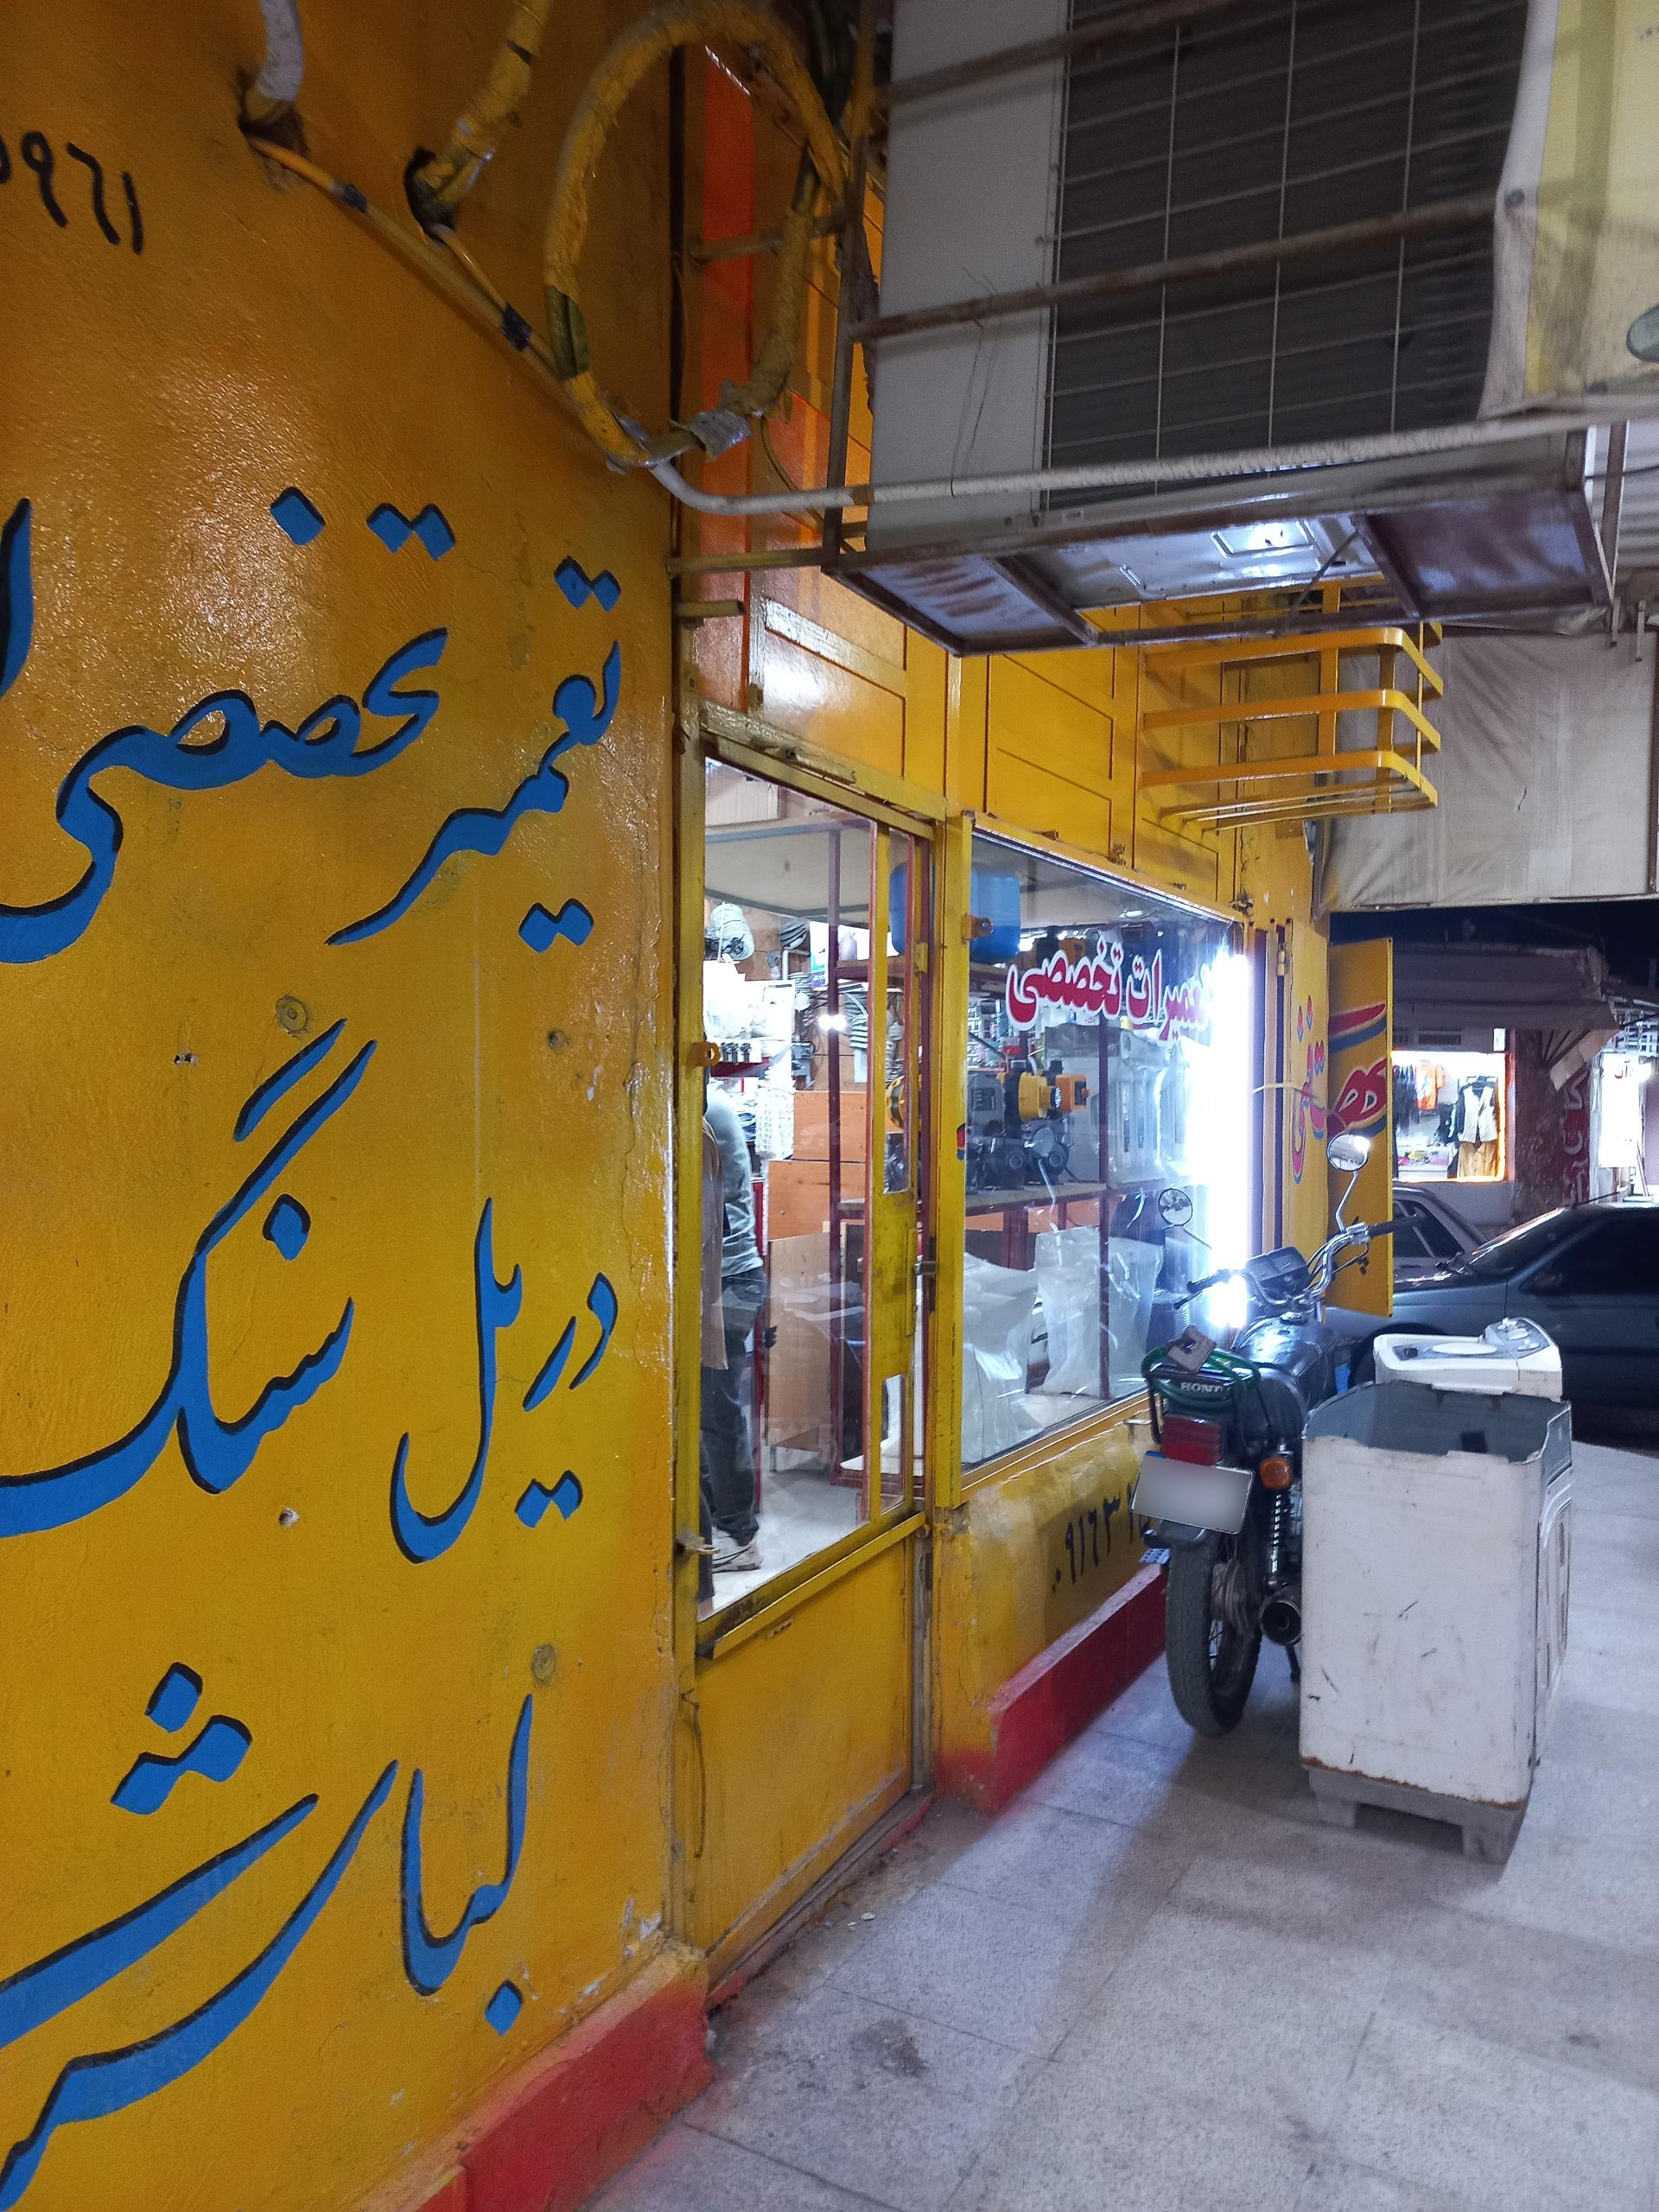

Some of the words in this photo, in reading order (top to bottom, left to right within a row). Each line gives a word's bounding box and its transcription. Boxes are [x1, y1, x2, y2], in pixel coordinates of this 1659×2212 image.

[1005, 937, 1123, 1032] تخصصی
[0, 1018, 378, 1538] سنگ
[390, 1197, 618, 1565] دریل
